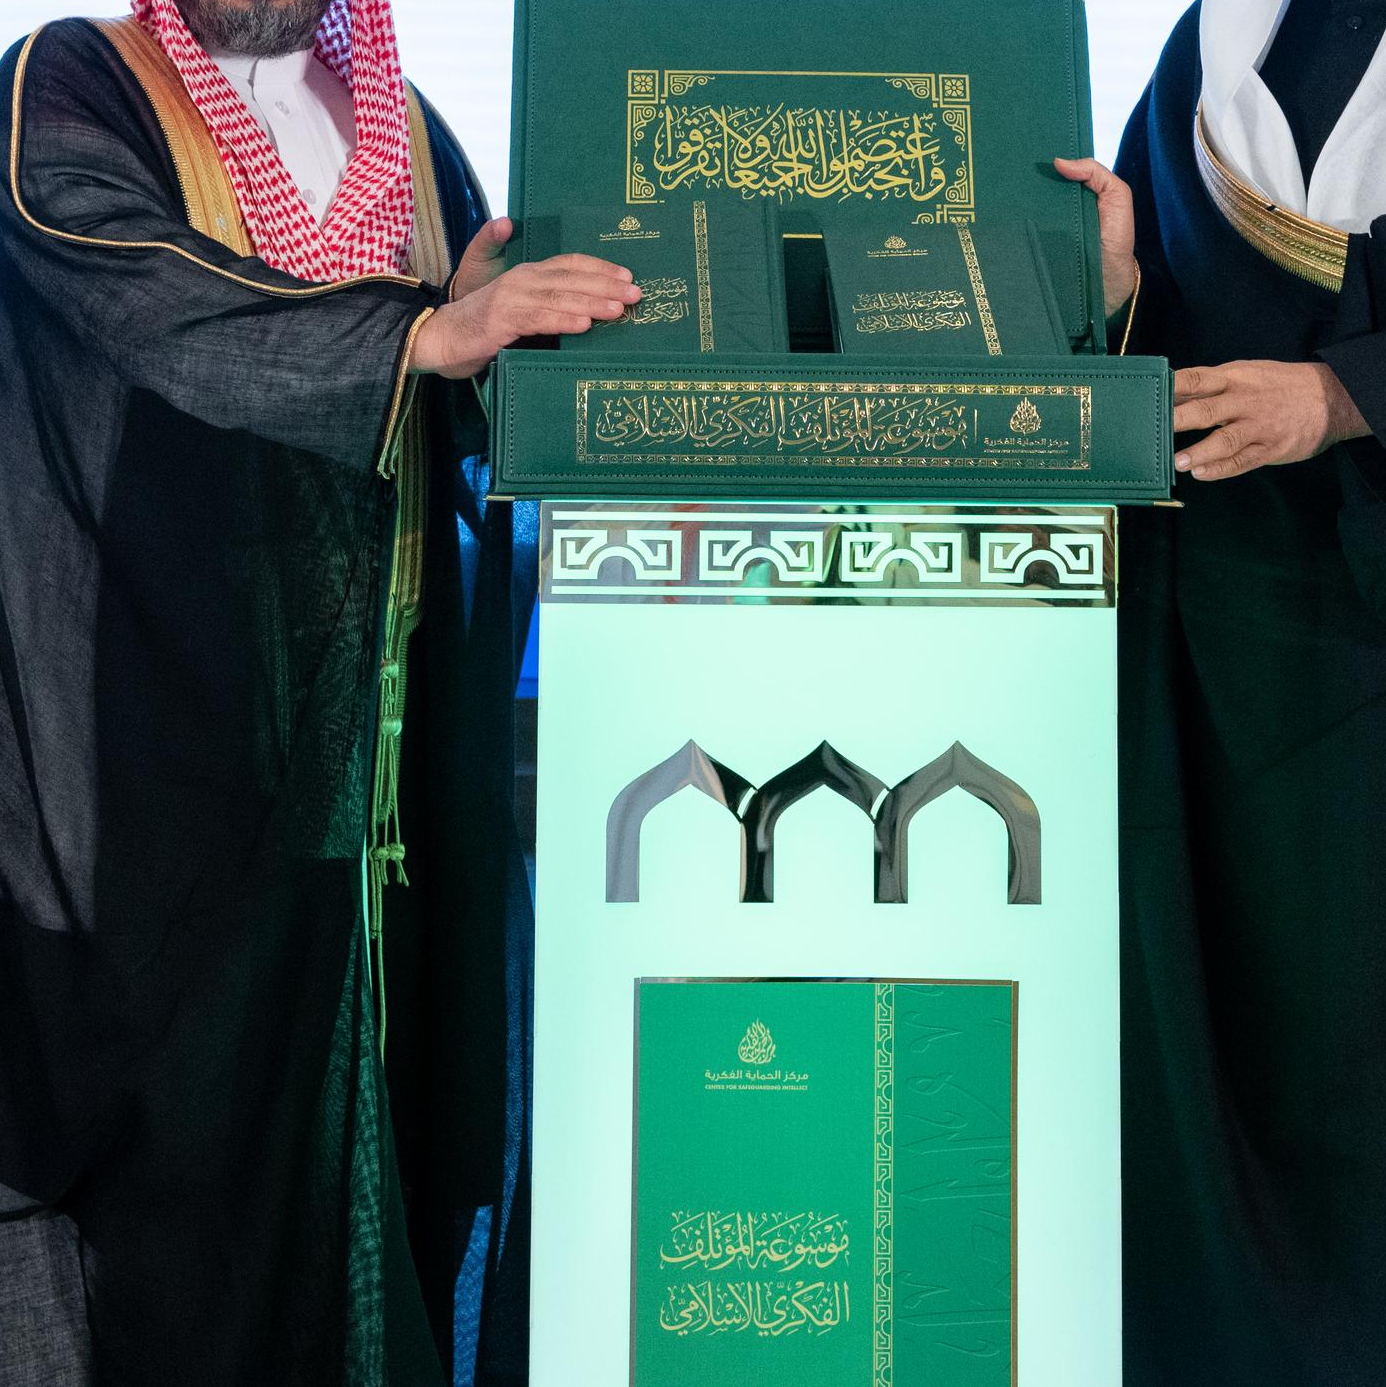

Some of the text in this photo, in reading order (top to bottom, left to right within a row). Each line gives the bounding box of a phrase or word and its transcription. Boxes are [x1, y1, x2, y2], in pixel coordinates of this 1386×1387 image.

[704, 1069, 809, 1083] مركز الحماية الفكرية
[753, 1280, 851, 1336] الفكري
